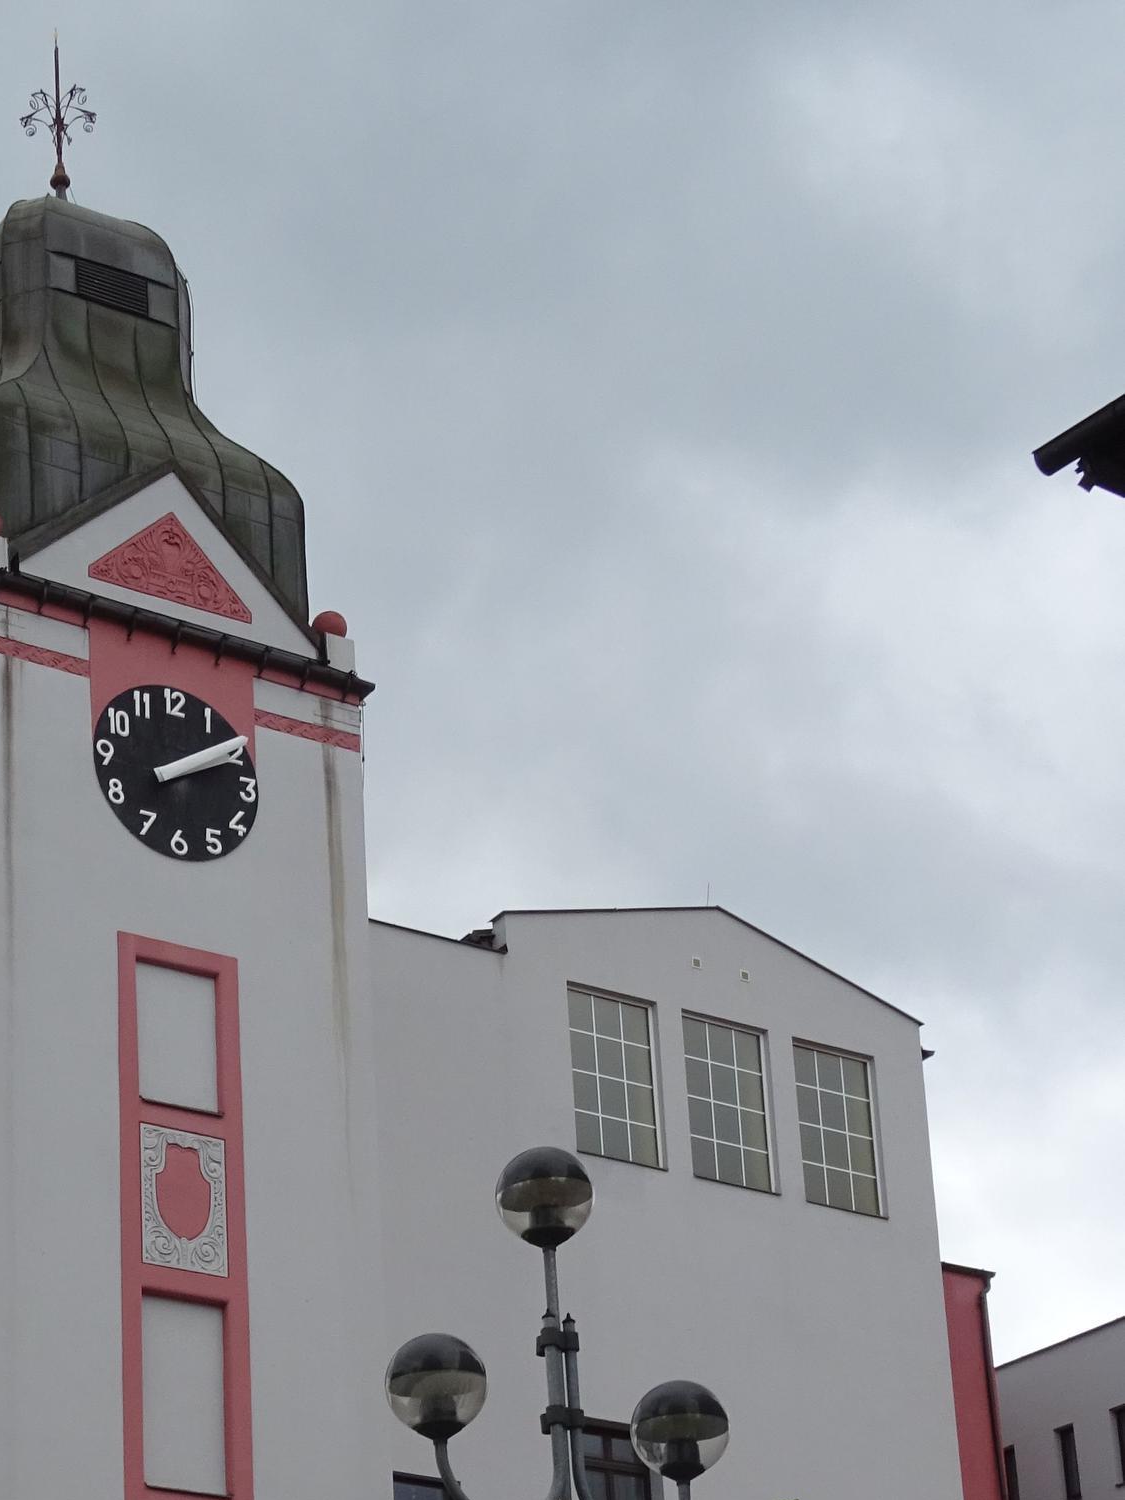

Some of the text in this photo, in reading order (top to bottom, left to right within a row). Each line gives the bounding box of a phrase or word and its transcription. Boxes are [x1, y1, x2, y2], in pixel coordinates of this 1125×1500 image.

[134, 690, 150, 719] 11
[164, 688, 185, 718] 12
[108, 707, 129, 737] 10
[204, 707, 211, 733] 1
[96, 739, 114, 765] 9
[108, 778, 124, 804] 8
[239, 777, 256, 803] 3
[139, 810, 157, 835] 7
[229, 811, 247, 837] 4
[171, 829, 188, 856] 6
[206, 828, 222, 855] 5
